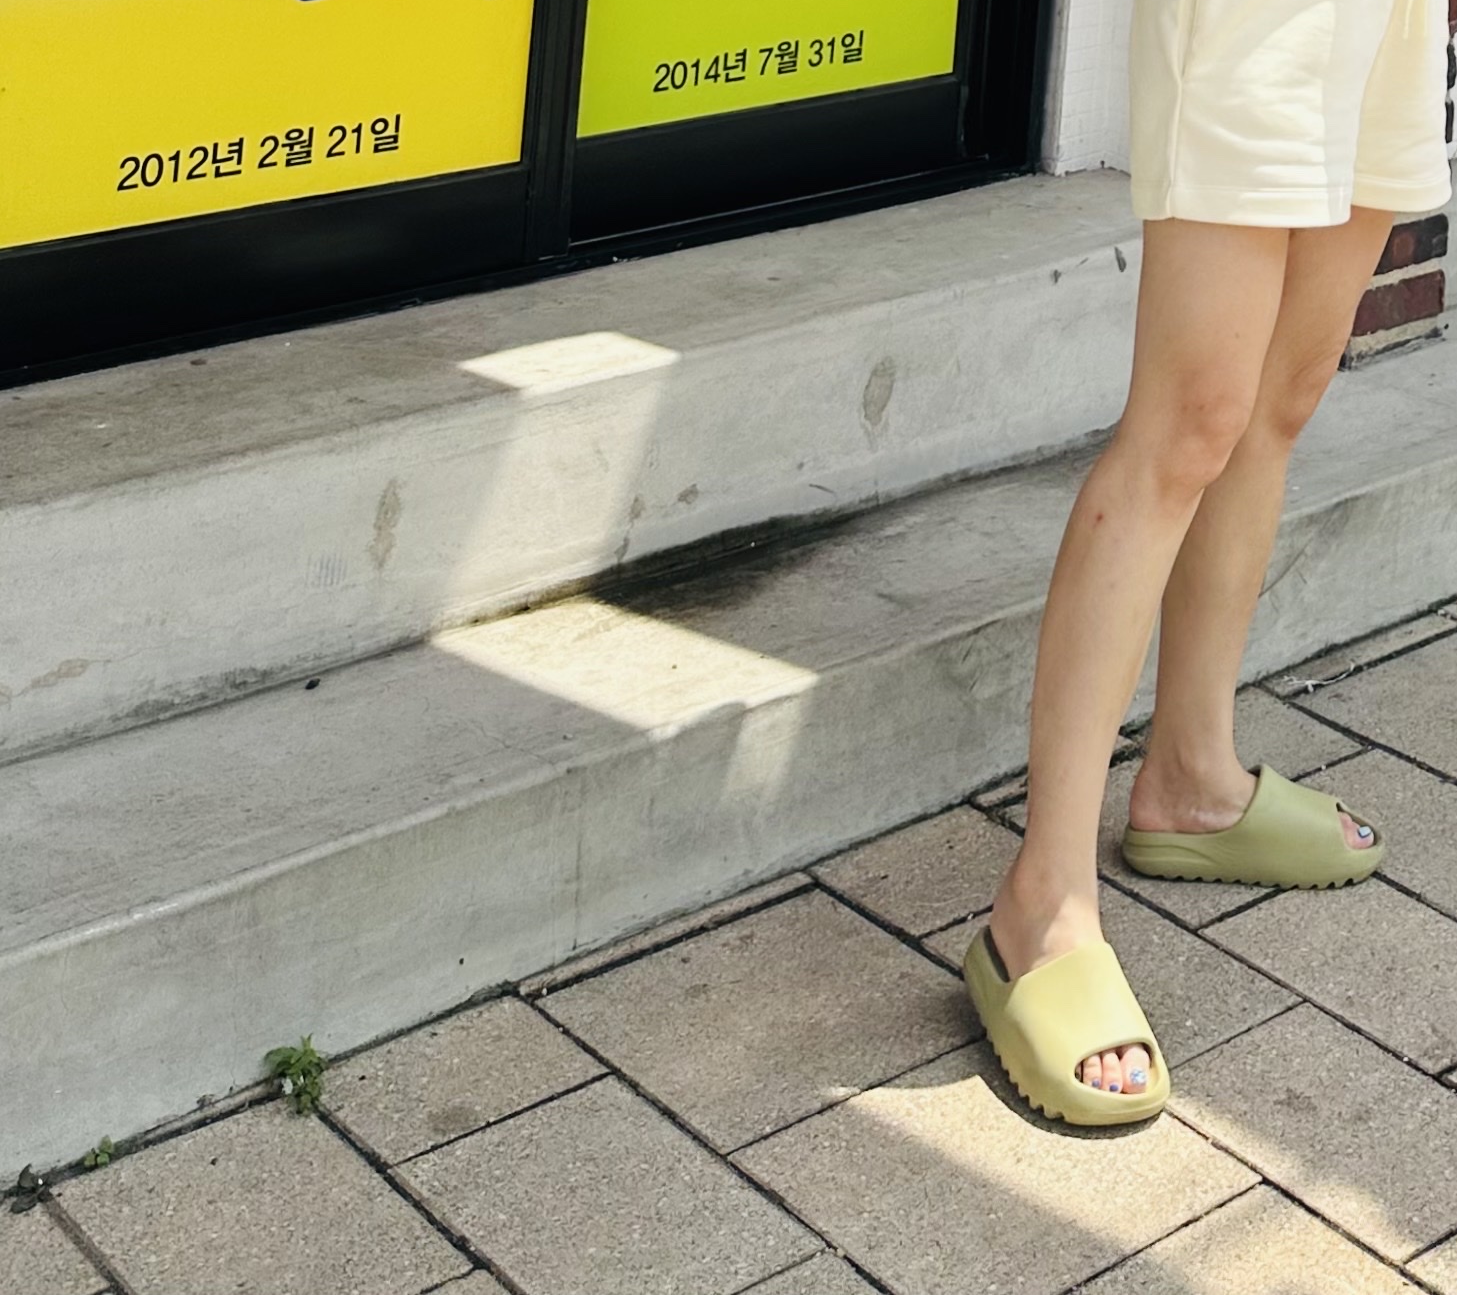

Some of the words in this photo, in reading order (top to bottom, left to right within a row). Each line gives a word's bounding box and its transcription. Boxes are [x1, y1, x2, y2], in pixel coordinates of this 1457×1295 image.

[653, 49, 747, 92] 2014년
[758, 40, 799, 78] 7월
[807, 30, 864, 67] 31일
[116, 138, 244, 191] 2012년
[256, 126, 314, 170] 2월
[328, 114, 401, 156] 21일
